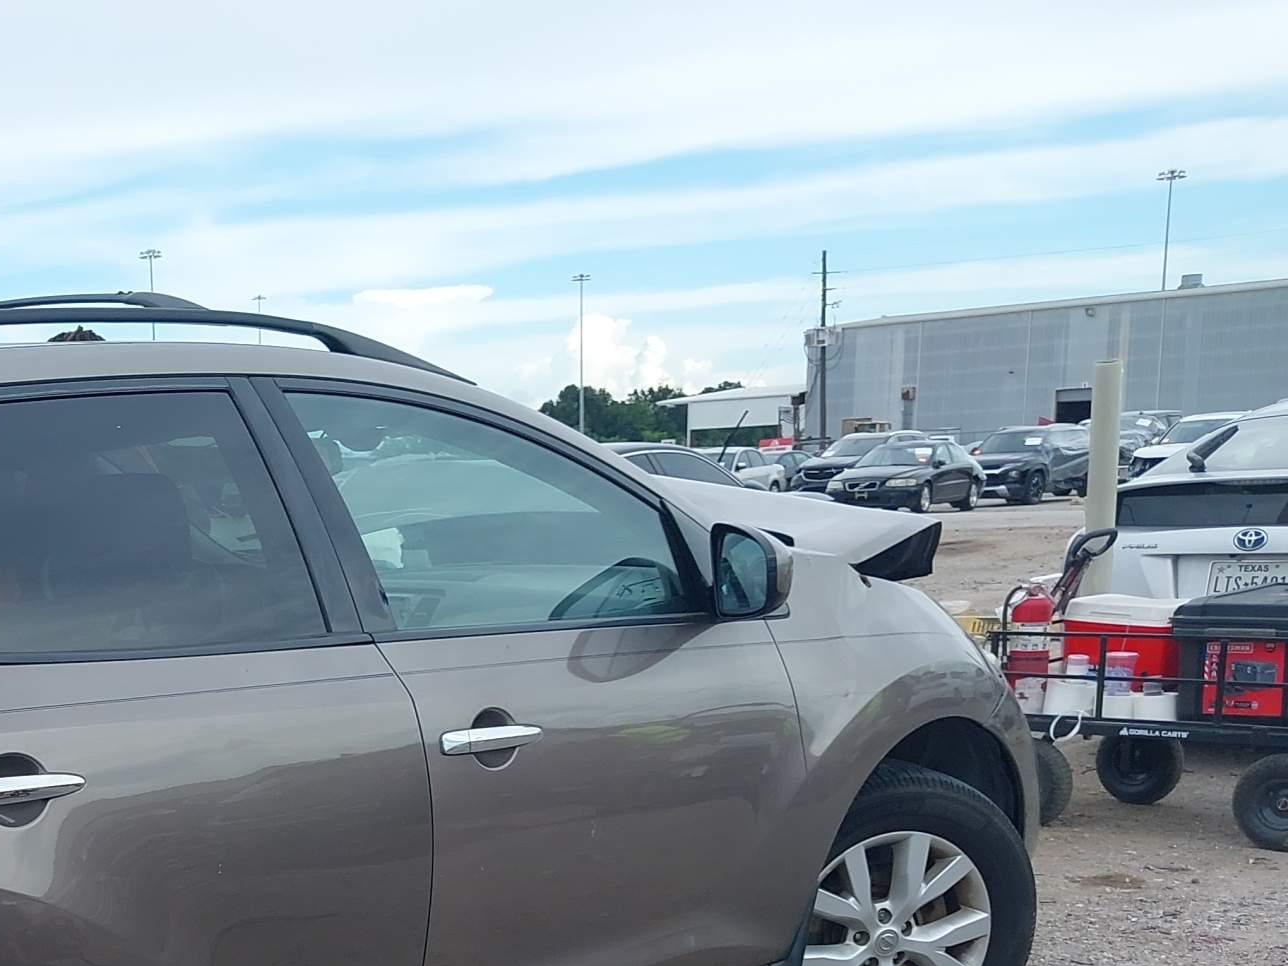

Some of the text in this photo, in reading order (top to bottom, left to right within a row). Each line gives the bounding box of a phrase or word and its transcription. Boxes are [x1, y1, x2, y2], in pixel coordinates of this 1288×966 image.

[1237, 564, 1270, 573] TEXAS
[1128, 728, 1190, 739] GORILLA CARTS
